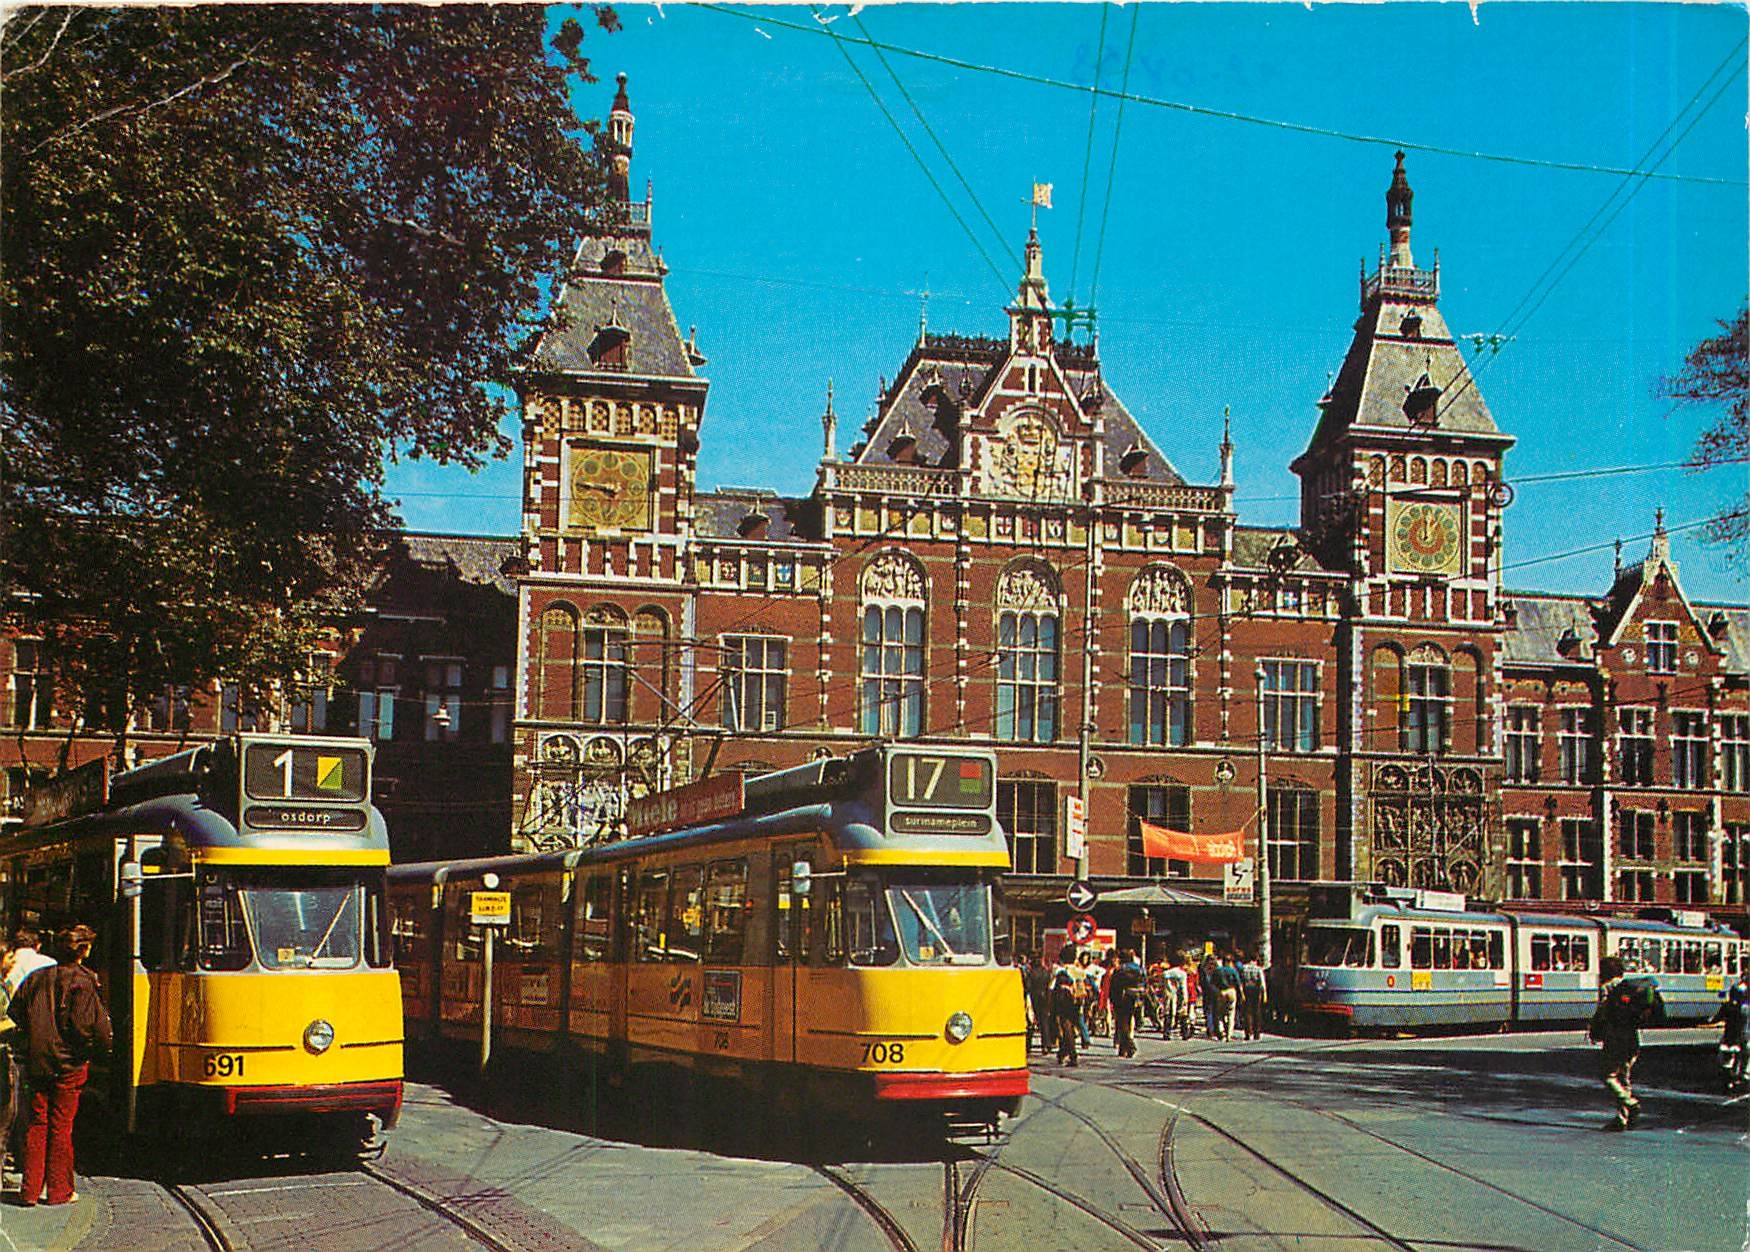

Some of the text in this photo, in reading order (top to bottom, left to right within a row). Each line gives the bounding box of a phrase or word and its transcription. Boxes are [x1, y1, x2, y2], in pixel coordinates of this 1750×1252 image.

[273, 749, 293, 798] 1
[906, 757, 946, 800] 17
[280, 811, 332, 826] osdorp
[905, 816, 978, 829] surinameplein
[861, 1043, 904, 1063] 708
[203, 1055, 245, 1077] 691
